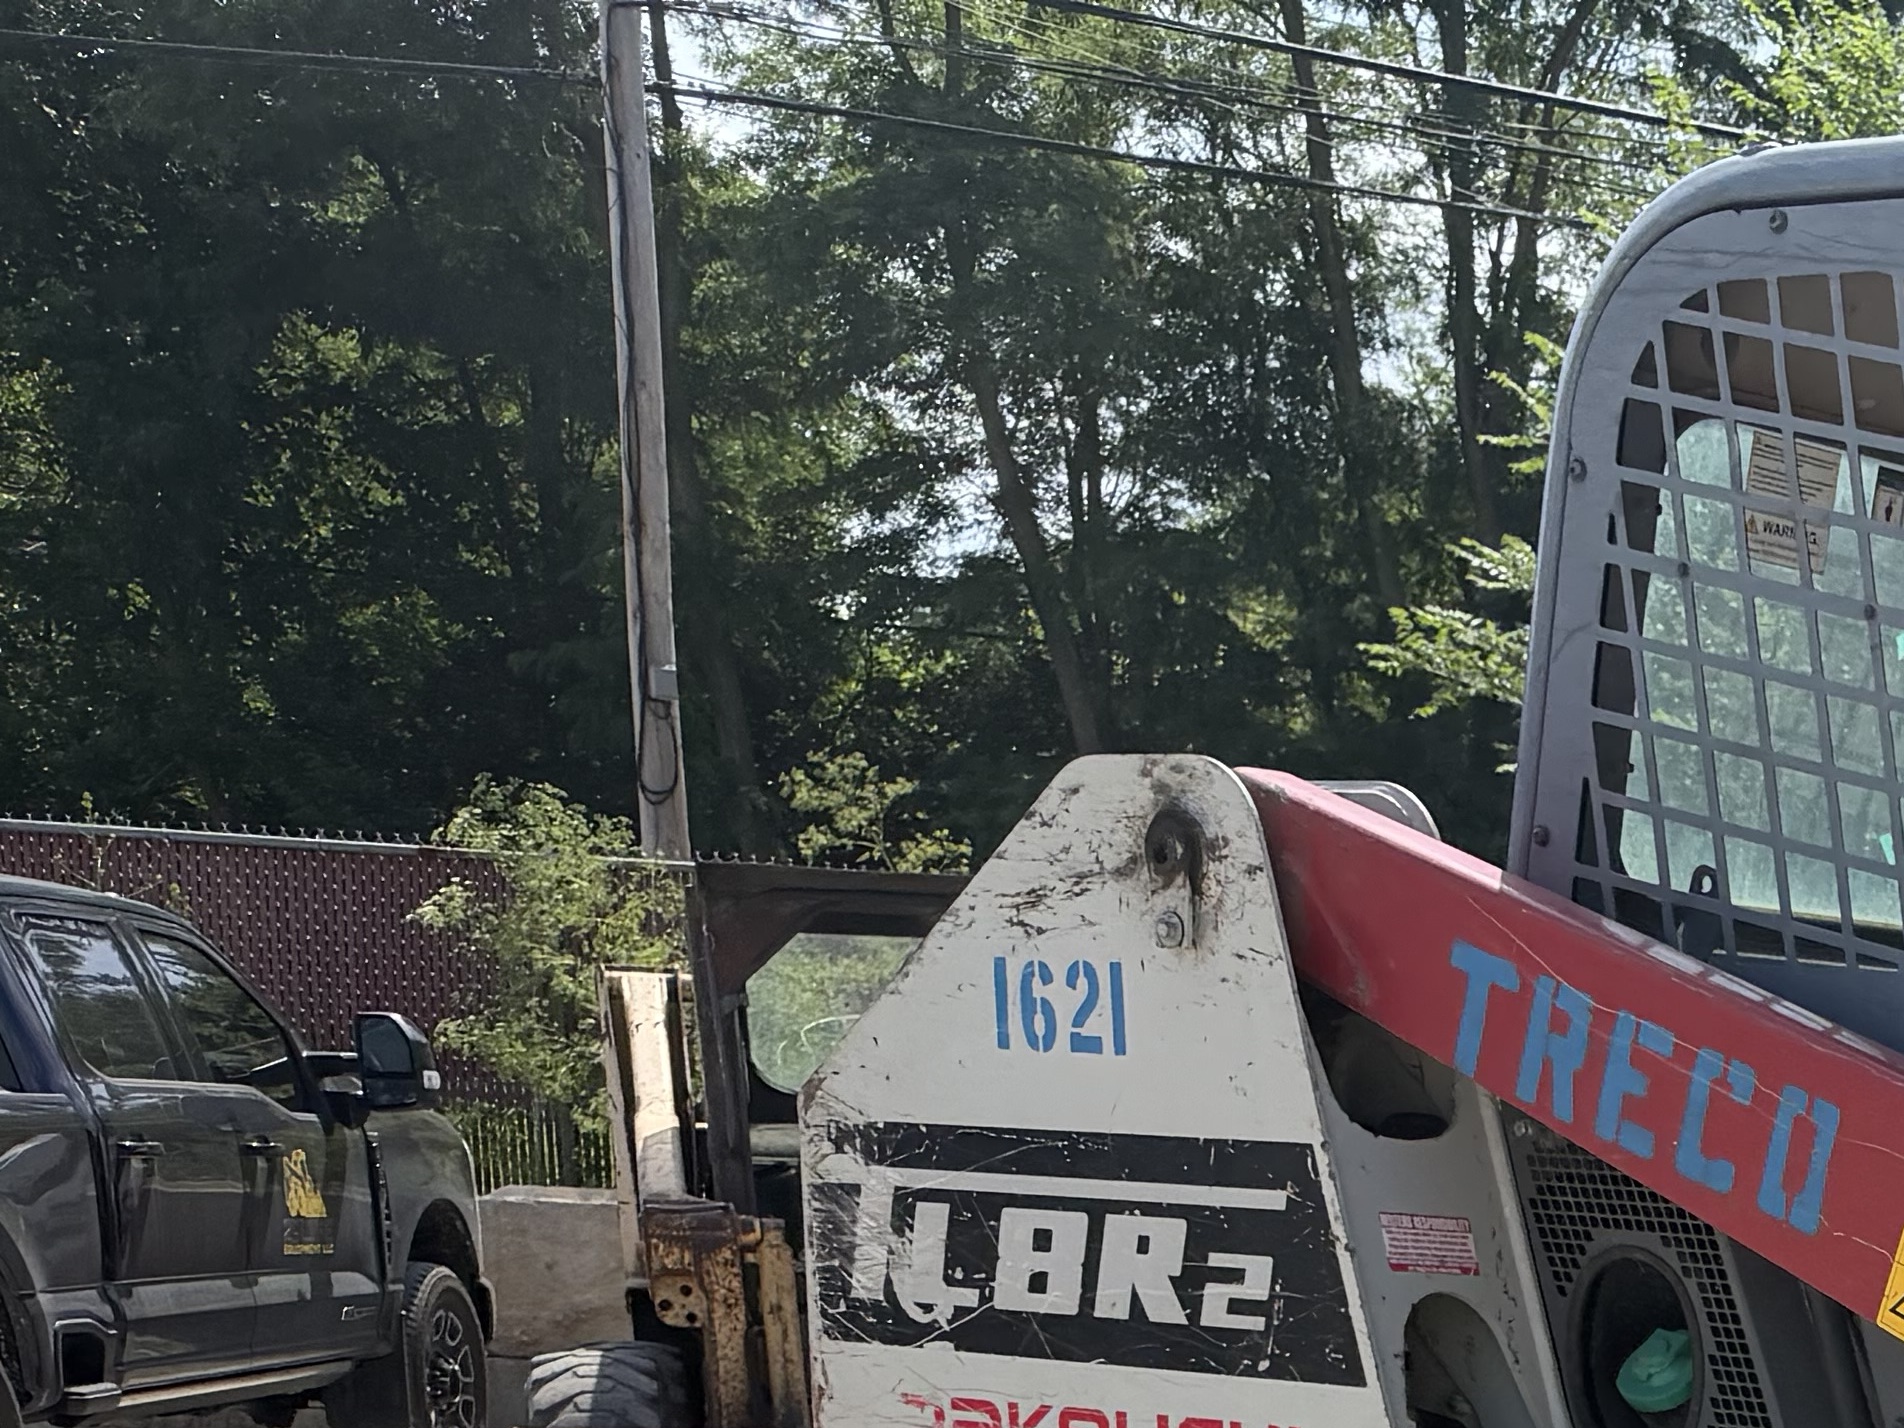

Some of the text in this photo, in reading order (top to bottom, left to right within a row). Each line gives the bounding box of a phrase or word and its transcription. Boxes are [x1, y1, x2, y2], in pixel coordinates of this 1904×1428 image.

[1762, 519, 1818, 546] WARNG
[993, 956, 1126, 1056] 1621
[1450, 938, 1840, 1236] TRECO
